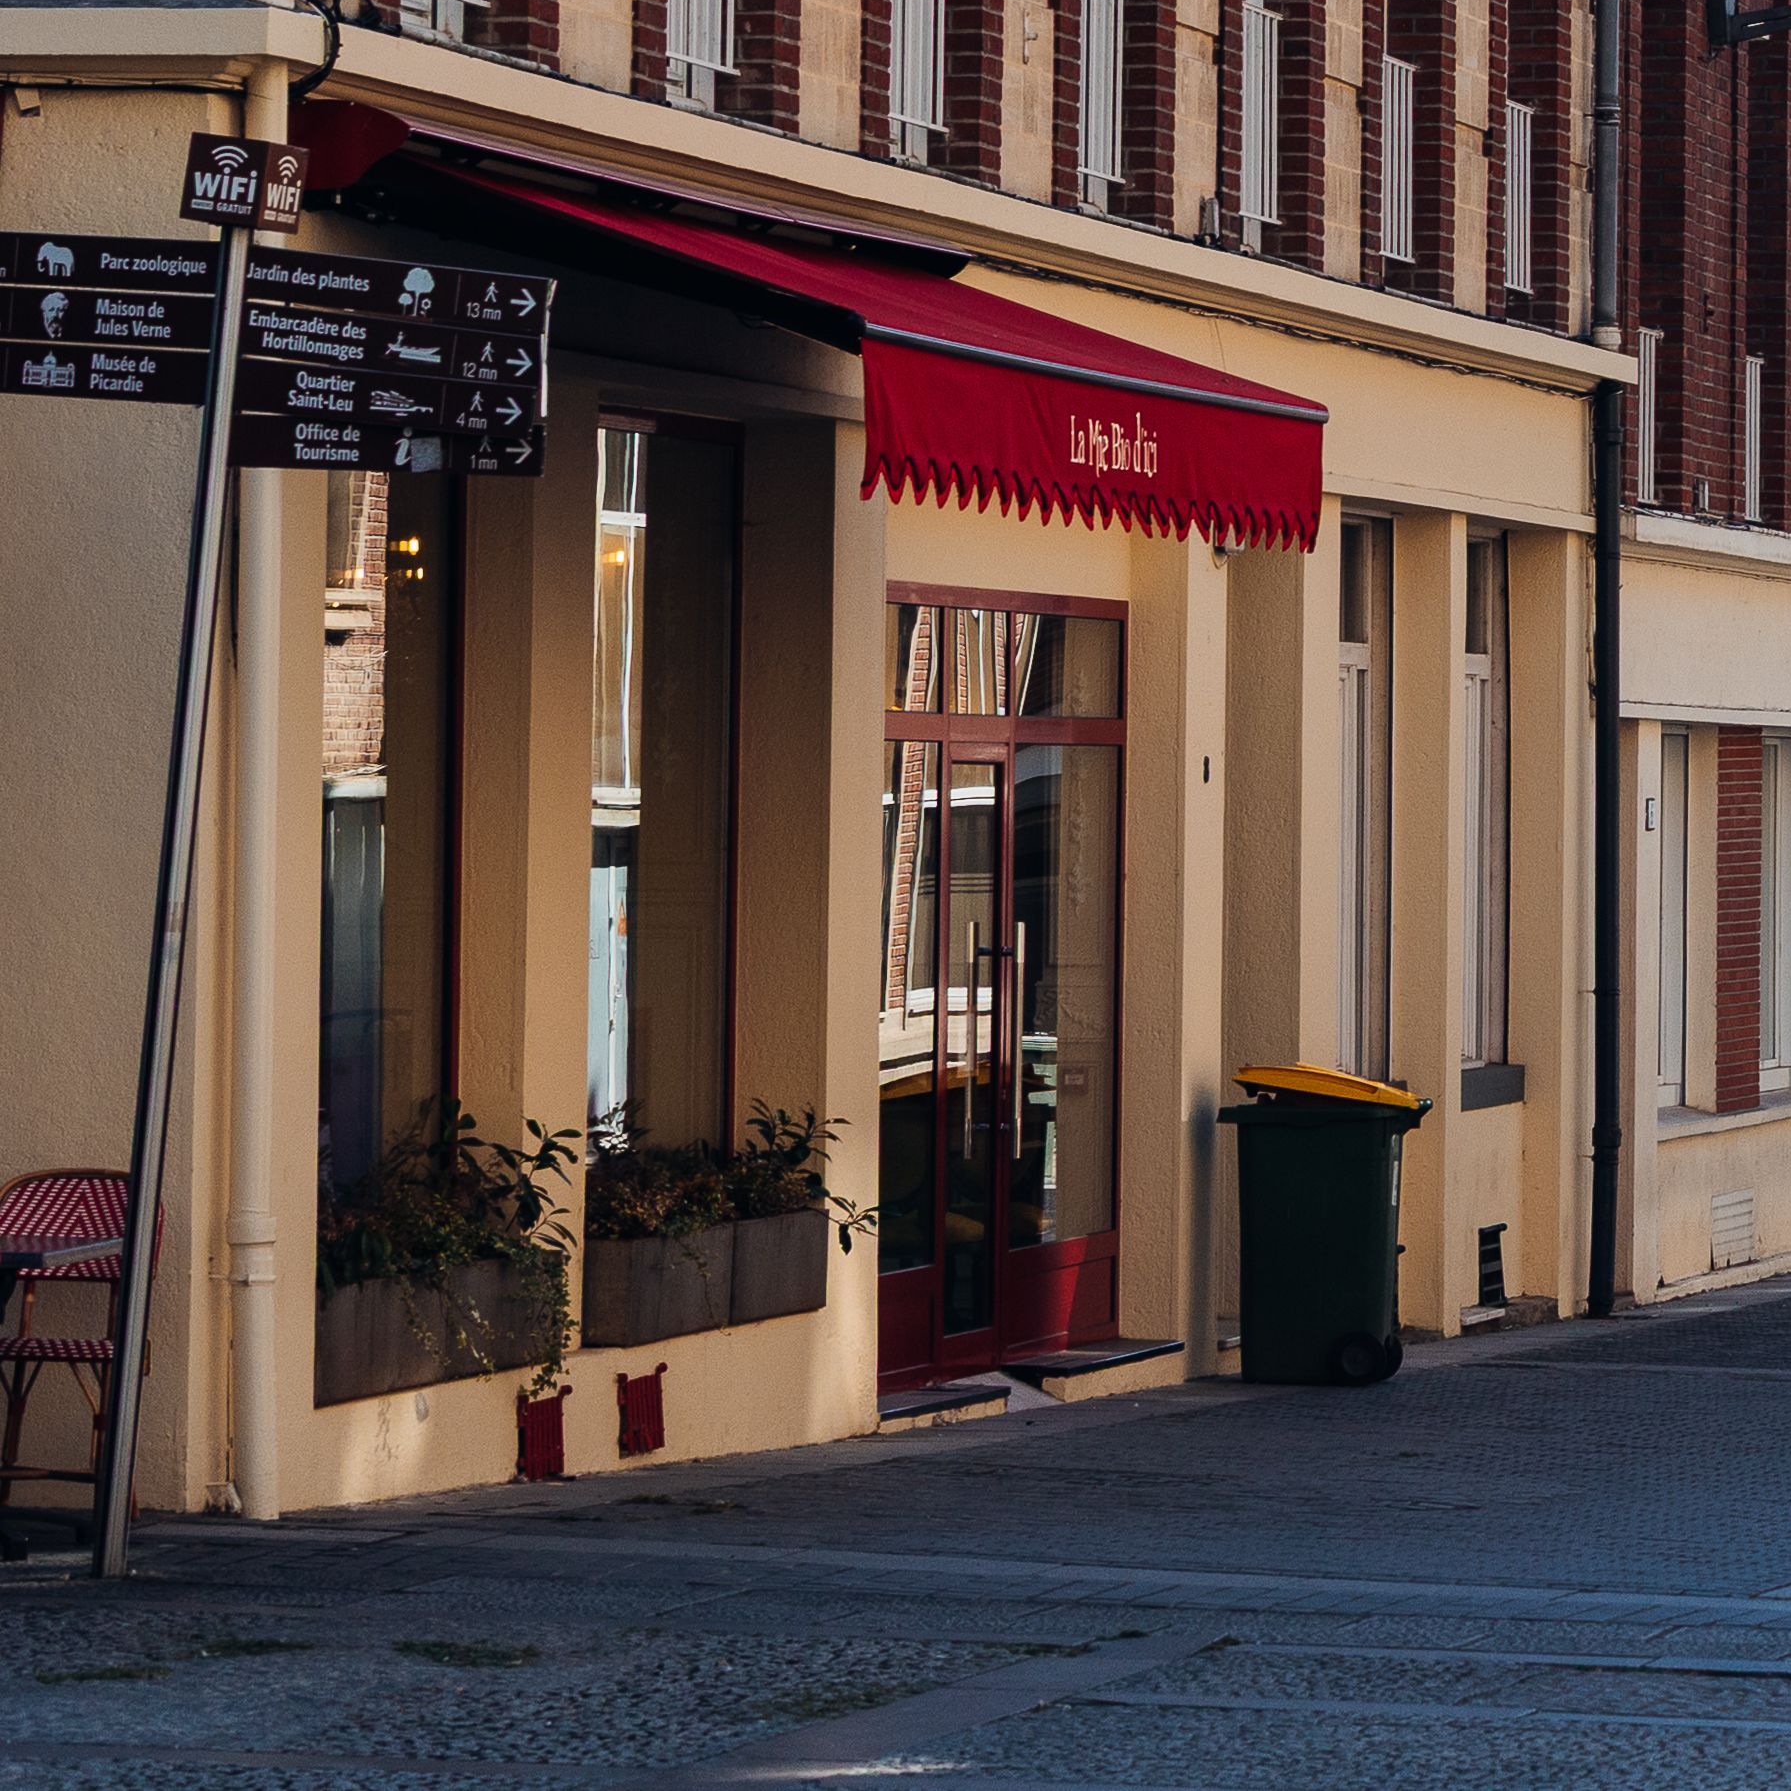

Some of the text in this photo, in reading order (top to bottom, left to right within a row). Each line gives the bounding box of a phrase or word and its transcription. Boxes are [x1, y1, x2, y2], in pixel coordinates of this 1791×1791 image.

[100, 253, 207, 276] Parc zoologique
[247, 262, 370, 292] Jardin des plantes
[95, 298, 165, 318] Maison de
[466, 302, 502, 320] 13 mn
[94, 319, 171, 338] Jules Verne
[249, 310, 367, 340] Embarcadère des
[261, 331, 364, 361] Hortillonnages
[91, 353, 156, 373] Musée de
[462, 362, 498, 380] 12 mn
[89, 373, 144, 392] Picardie
[296, 371, 356, 392] Quartier
[287, 390, 354, 412] Saint-Leu
[456, 413, 487, 429] 4 mn
[295, 423, 361, 442] Office de
[294, 443, 360, 461] Tourisme
[1070, 412, 1158, 478] La Mie Bio d'ici
[470, 455, 498, 470] 1 mn
